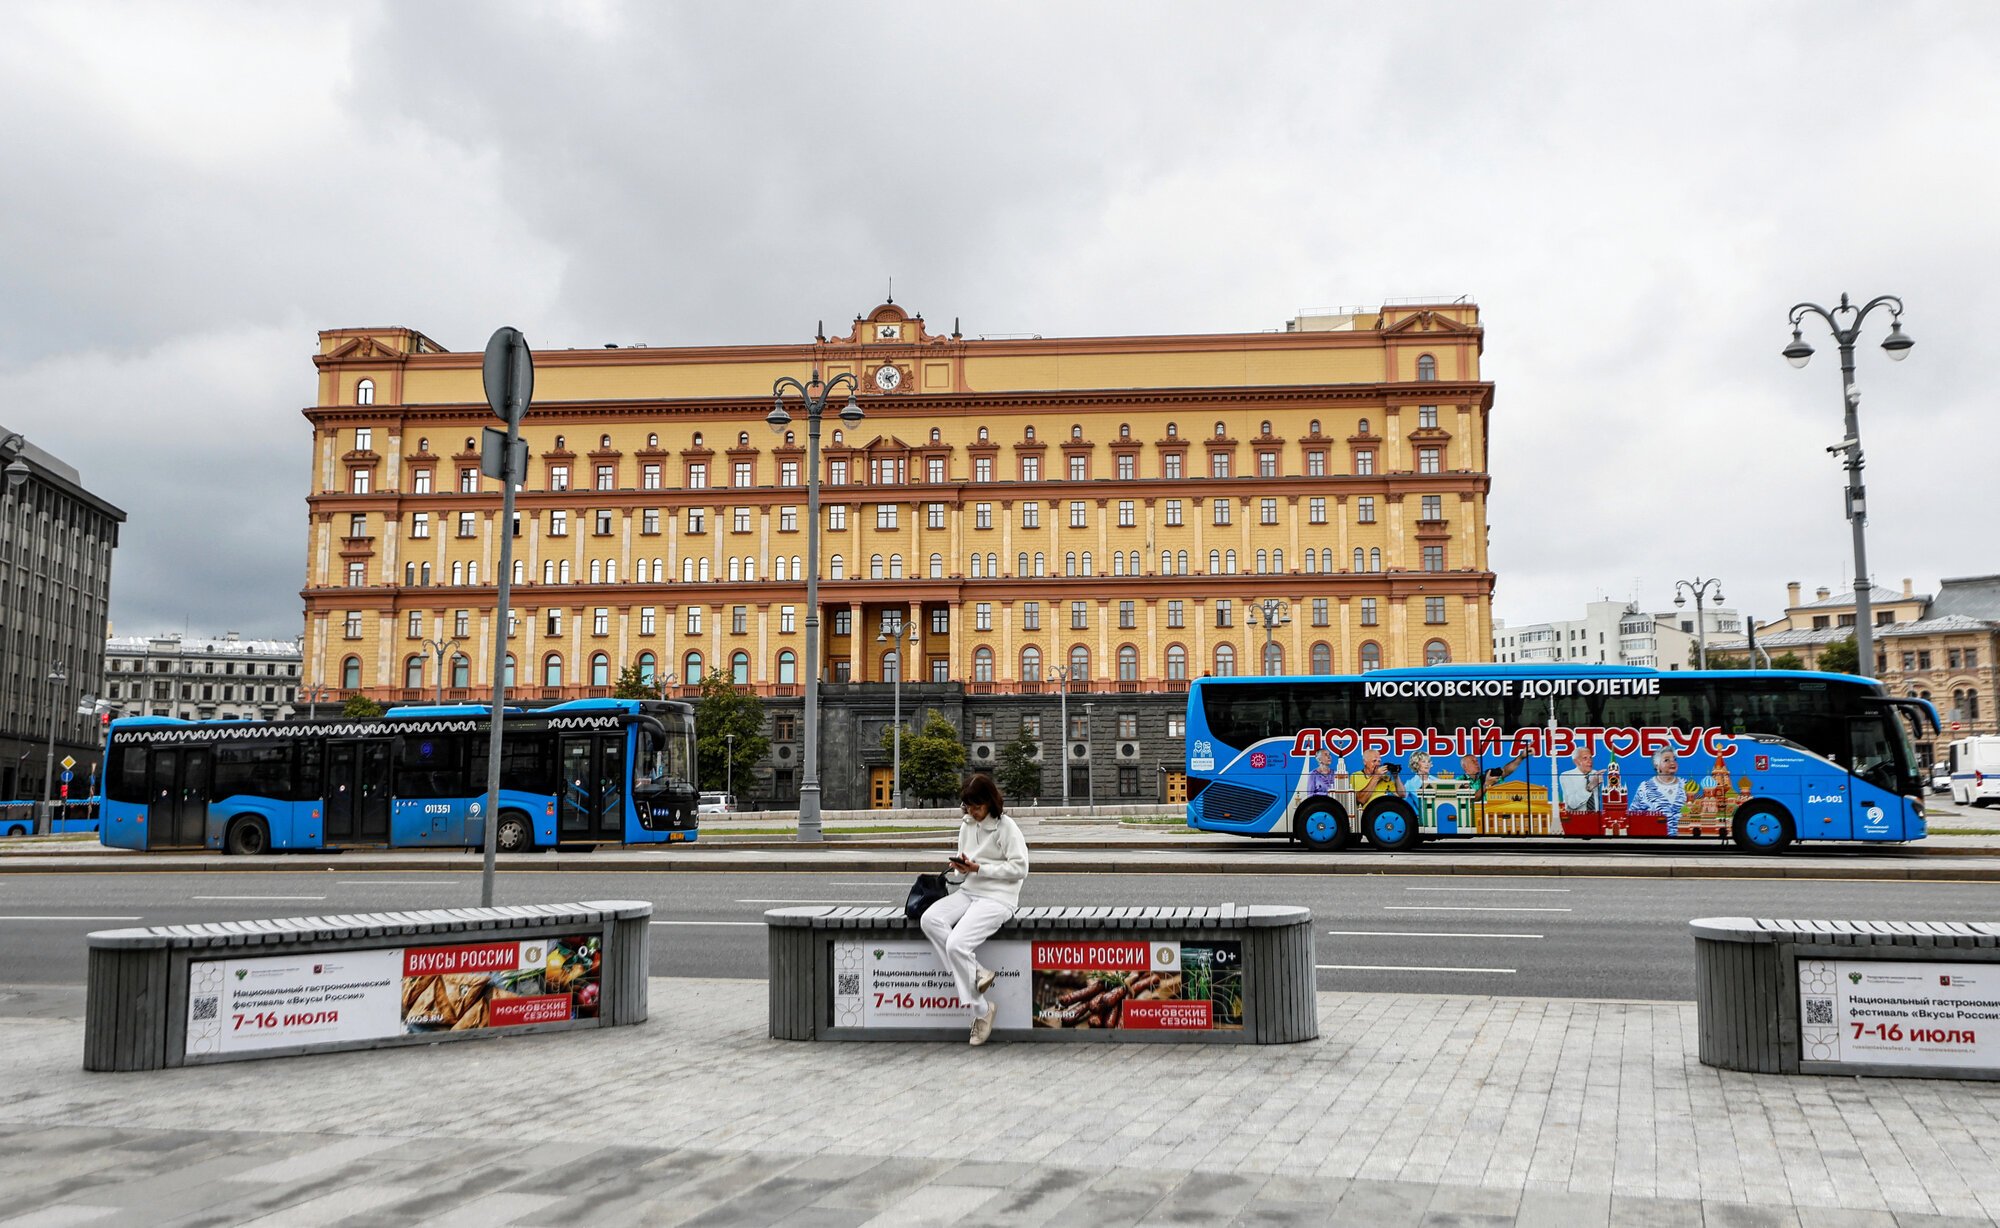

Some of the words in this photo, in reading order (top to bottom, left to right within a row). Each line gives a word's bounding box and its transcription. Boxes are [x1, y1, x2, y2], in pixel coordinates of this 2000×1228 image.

[1365, 680, 1513, 698] МОСКОВСКОЕ
[1520, 679, 1660, 699] ДОЛГОЛЕТИЕ
[1290, 718, 1502, 758] ДОБРЫЙ
[1510, 726, 1738, 758] АВТОБУС
[1808, 795, 1843, 804] ДА-001
[424, 804, 451, 814] 011351
[578, 945, 596, 958] 0+
[1038, 947, 1084, 965] ВКУСЫ
[1089, 947, 1145, 965] РОССИИ
[1215, 950, 1237, 963] 0+
[409, 952, 456, 972] ВКУСЫ
[460, 948, 514, 968] РОССИИ
[873, 969, 936, 978] Национальный
[233, 984, 304, 999] Национальный
[305, 979, 391, 994] гастрономический
[873, 980, 919, 989] фестиваль
[921, 980, 955, 990] «Вкусы
[232, 1000, 284, 1011] фестиваль
[287, 995, 322, 1006] «Вкусы
[325, 993, 365, 1002] России»
[496, 1001, 567, 1016] МОСКОВСКИЕ
[920, 996, 971, 1009] июл
[1849, 995, 1930, 1006] Национальный
[1932, 999, 2000, 1009] гастрономи
[283, 1010, 339, 1027] июля
[523, 1009, 567, 1021] СЕЗОНЫ
[1130, 1008, 1207, 1017] МОСКОВСКИЕ
[1850, 1007, 1908, 1018] фестиваль
[1911, 1009, 1954, 1020] «Вкусы
[1160, 1017, 1207, 1026] СЕЗОНЫ
[1910, 1028, 1976, 1044] июля
